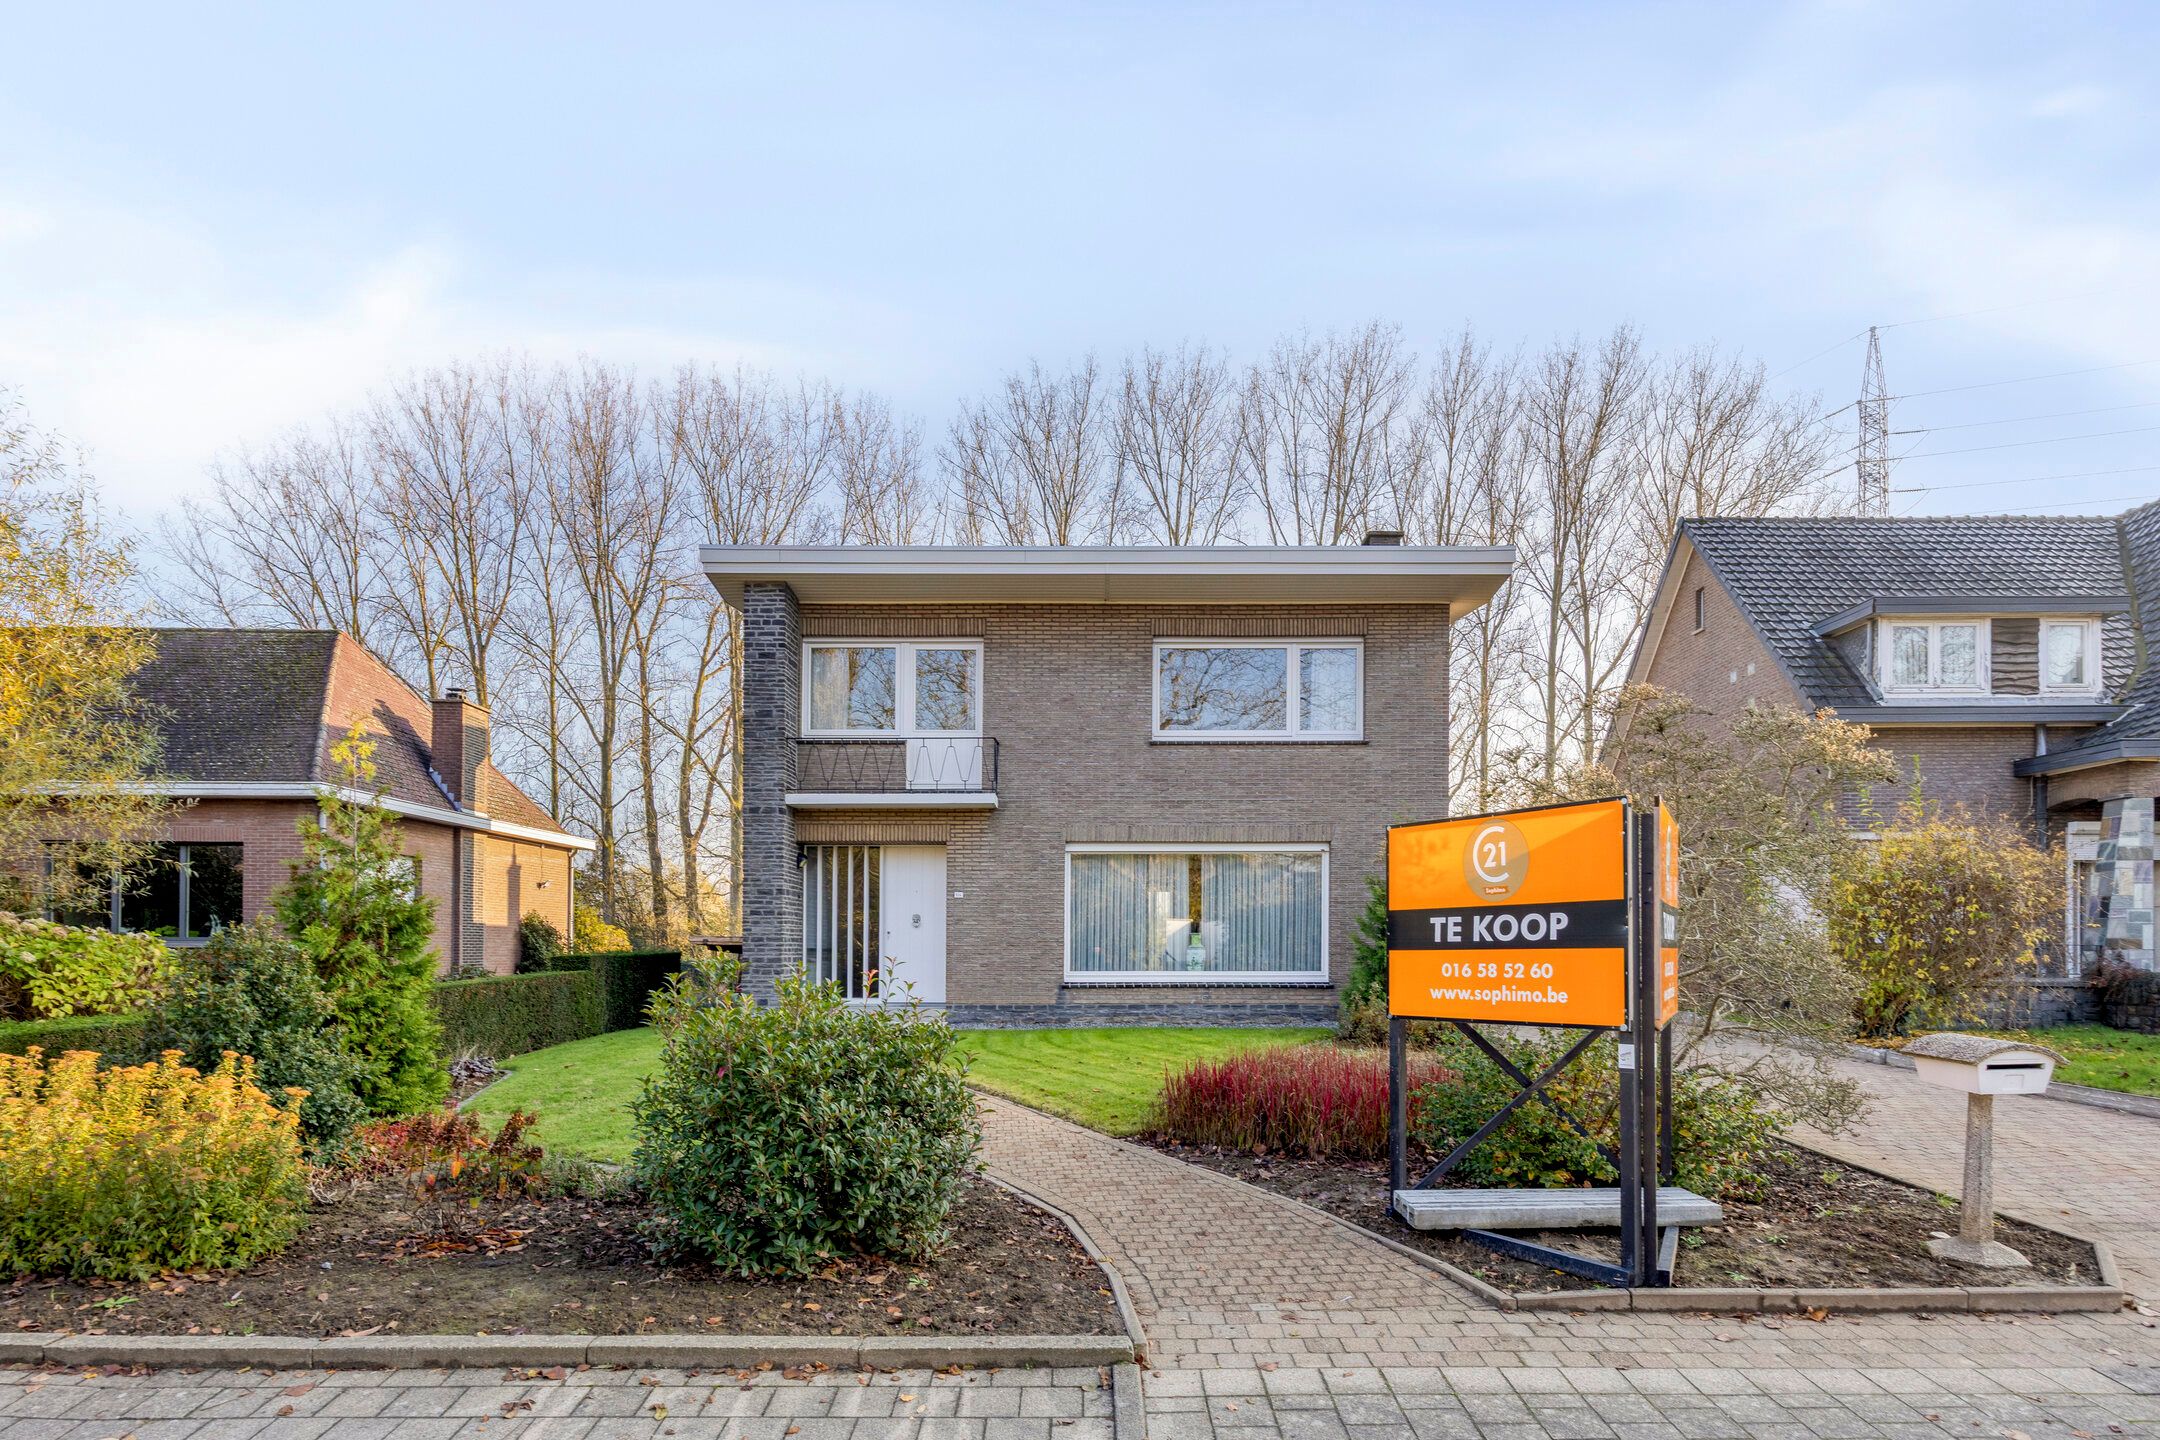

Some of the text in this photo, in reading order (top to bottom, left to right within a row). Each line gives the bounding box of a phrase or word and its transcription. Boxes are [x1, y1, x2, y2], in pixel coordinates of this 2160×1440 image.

[1430, 912, 1569, 942] TE KOOP
[1441, 963, 1554, 979] 016 58 52 60
[1430, 985, 1569, 1005] www.sophimo.be
